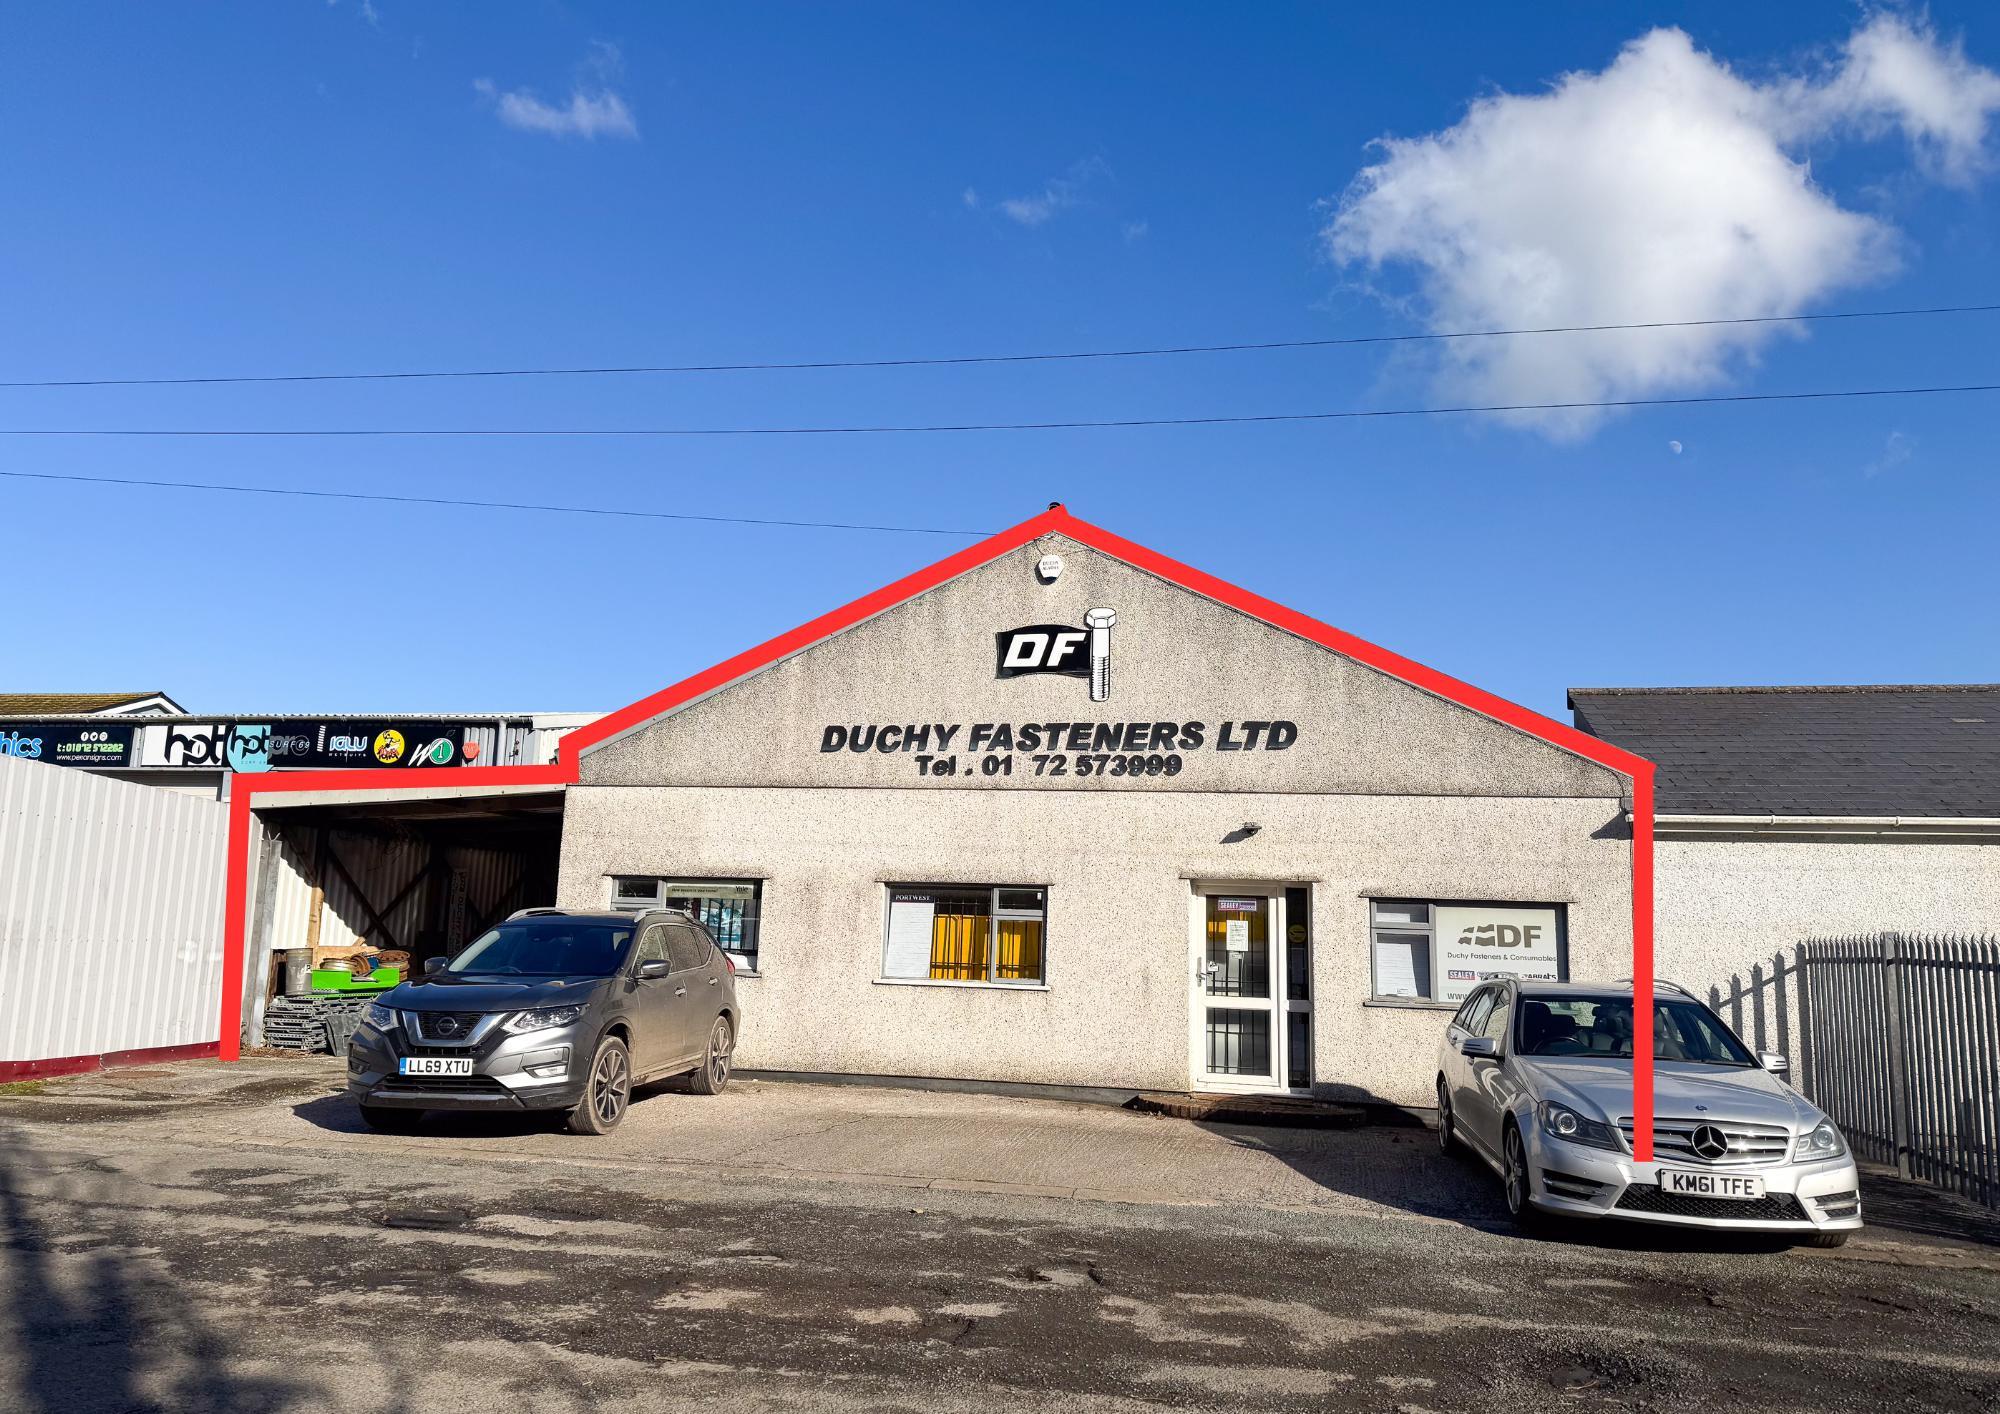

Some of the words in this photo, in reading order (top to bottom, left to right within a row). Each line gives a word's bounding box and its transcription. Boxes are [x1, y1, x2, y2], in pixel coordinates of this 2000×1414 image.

[1003, 632, 1086, 667] DF
[164, 725, 225, 765] hot
[820, 724, 961, 753] DUCHY
[968, 722, 1206, 752] FASTENERS
[1216, 720, 1298, 751] LTD
[981, 755, 1012, 776] 01
[1032, 754, 1067, 776] 72
[1075, 754, 1183, 776] 573999
[1496, 924, 1541, 948] DF
[1447, 952, 1469, 960] Duchy
[1470, 952, 1502, 960] Fasteners
[1510, 954, 1557, 962] Consumables
[408, 1060, 441, 1073] LL69
[445, 1060, 470, 1073] XTU
[1673, 1174, 1715, 1194] KM61
[1720, 1178, 1754, 1195] TFE
